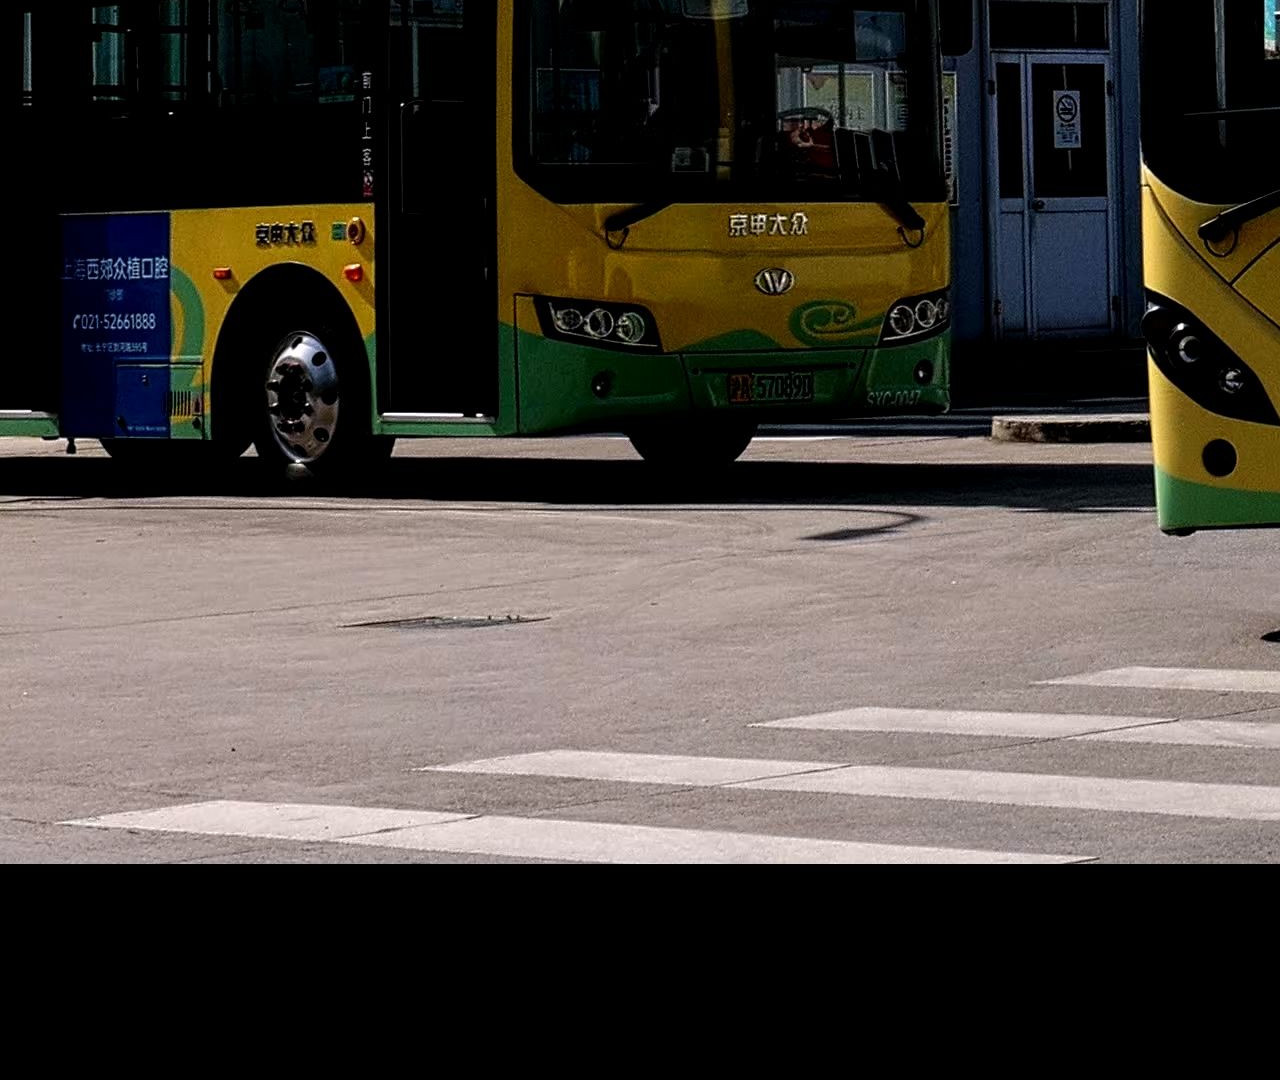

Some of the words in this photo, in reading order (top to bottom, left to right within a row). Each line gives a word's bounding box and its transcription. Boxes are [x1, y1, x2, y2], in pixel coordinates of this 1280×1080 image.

[729, 211, 809, 237] 京申大众
[81, 313, 156, 329] 021-52661888
